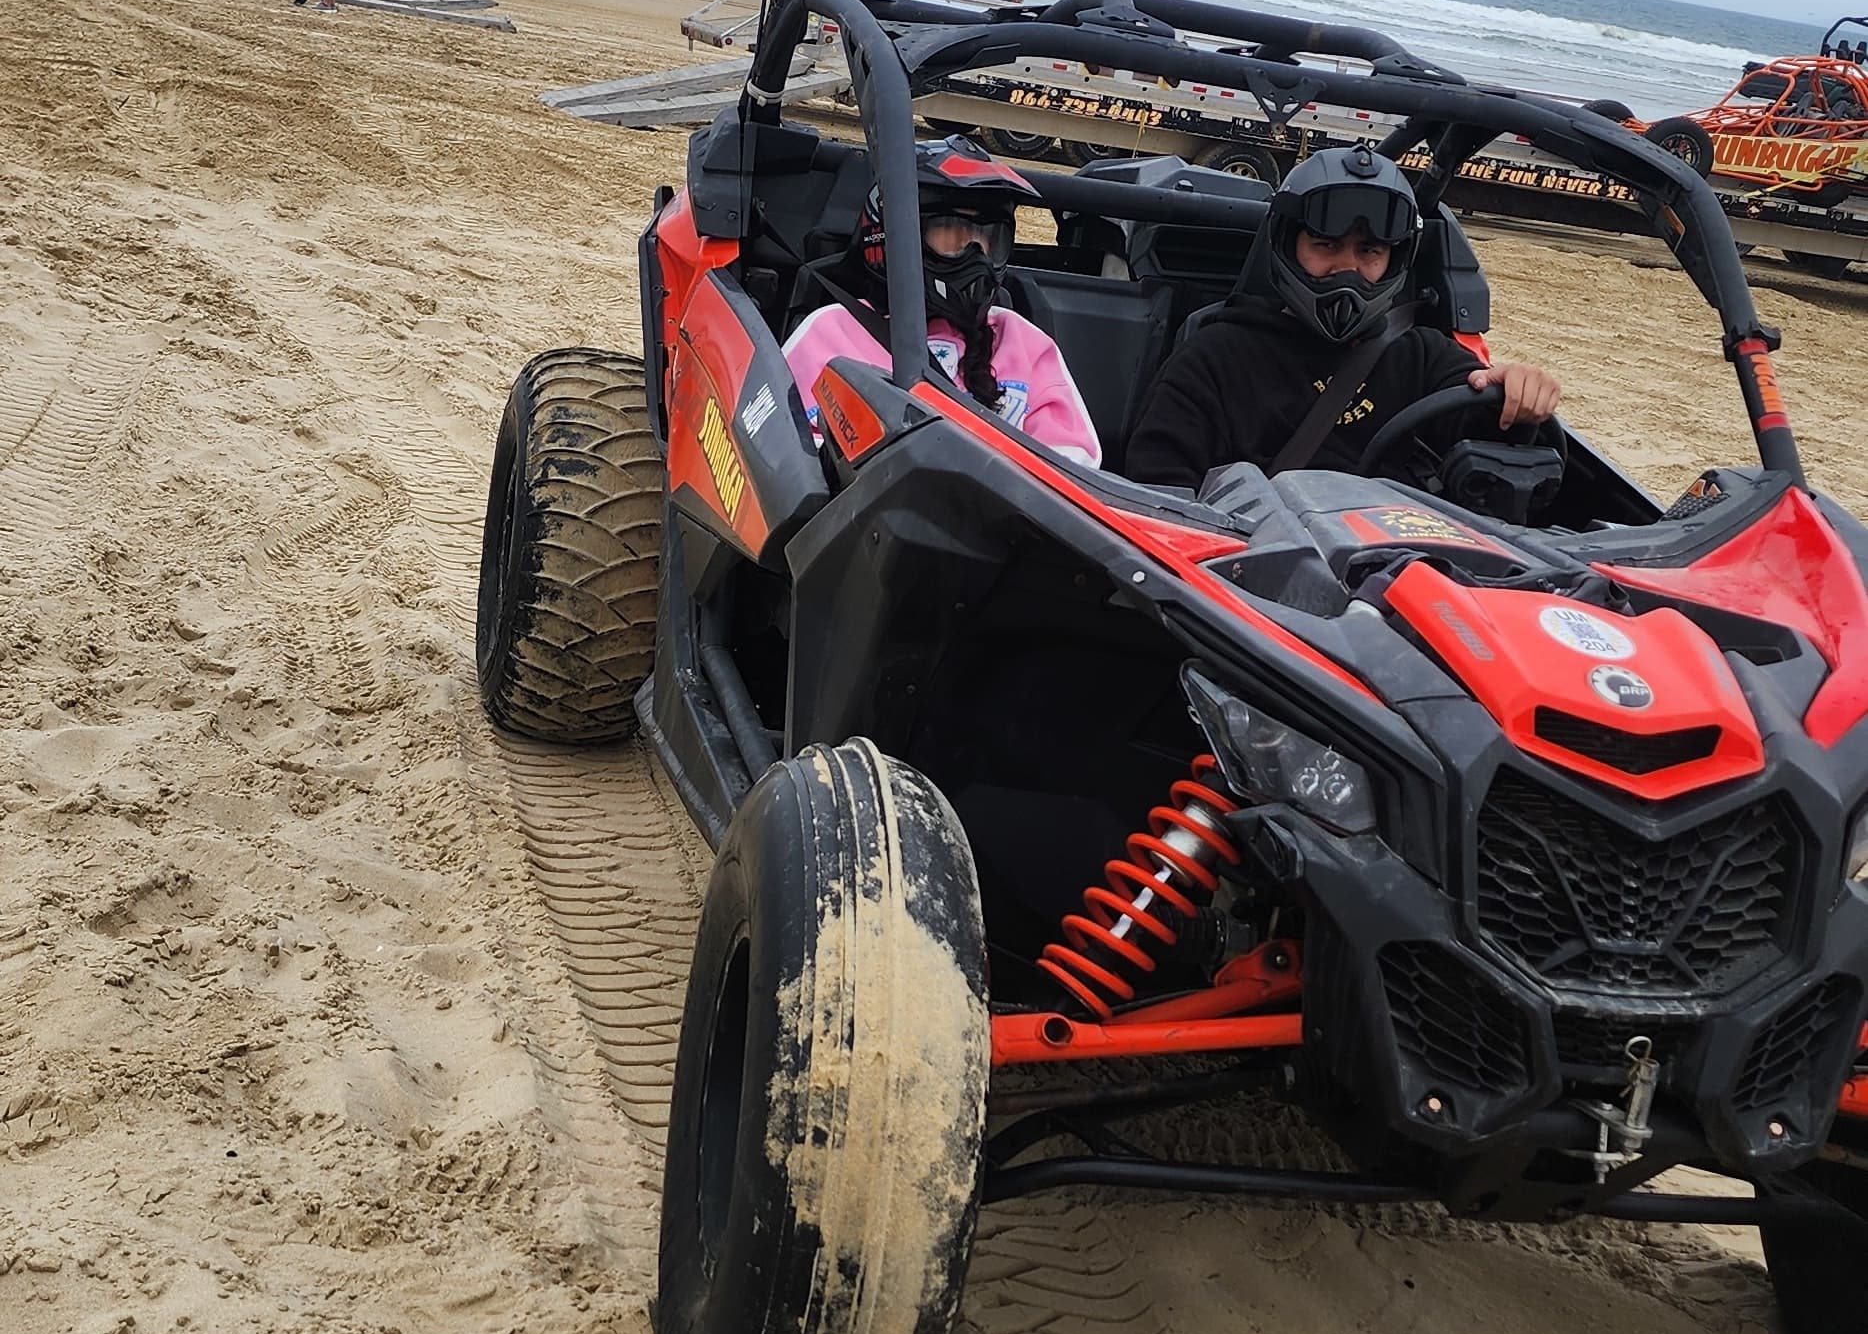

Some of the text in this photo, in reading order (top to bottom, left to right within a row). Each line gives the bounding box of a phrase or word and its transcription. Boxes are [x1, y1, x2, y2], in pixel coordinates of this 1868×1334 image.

[1460, 162, 1496, 180] THE
[1498, 168, 1537, 184] FUN
[1541, 175, 1602, 196] NEVER
[1606, 185, 1634, 200] SE
[1580, 639, 1618, 653] 204
[1620, 685, 1649, 697] BRP
